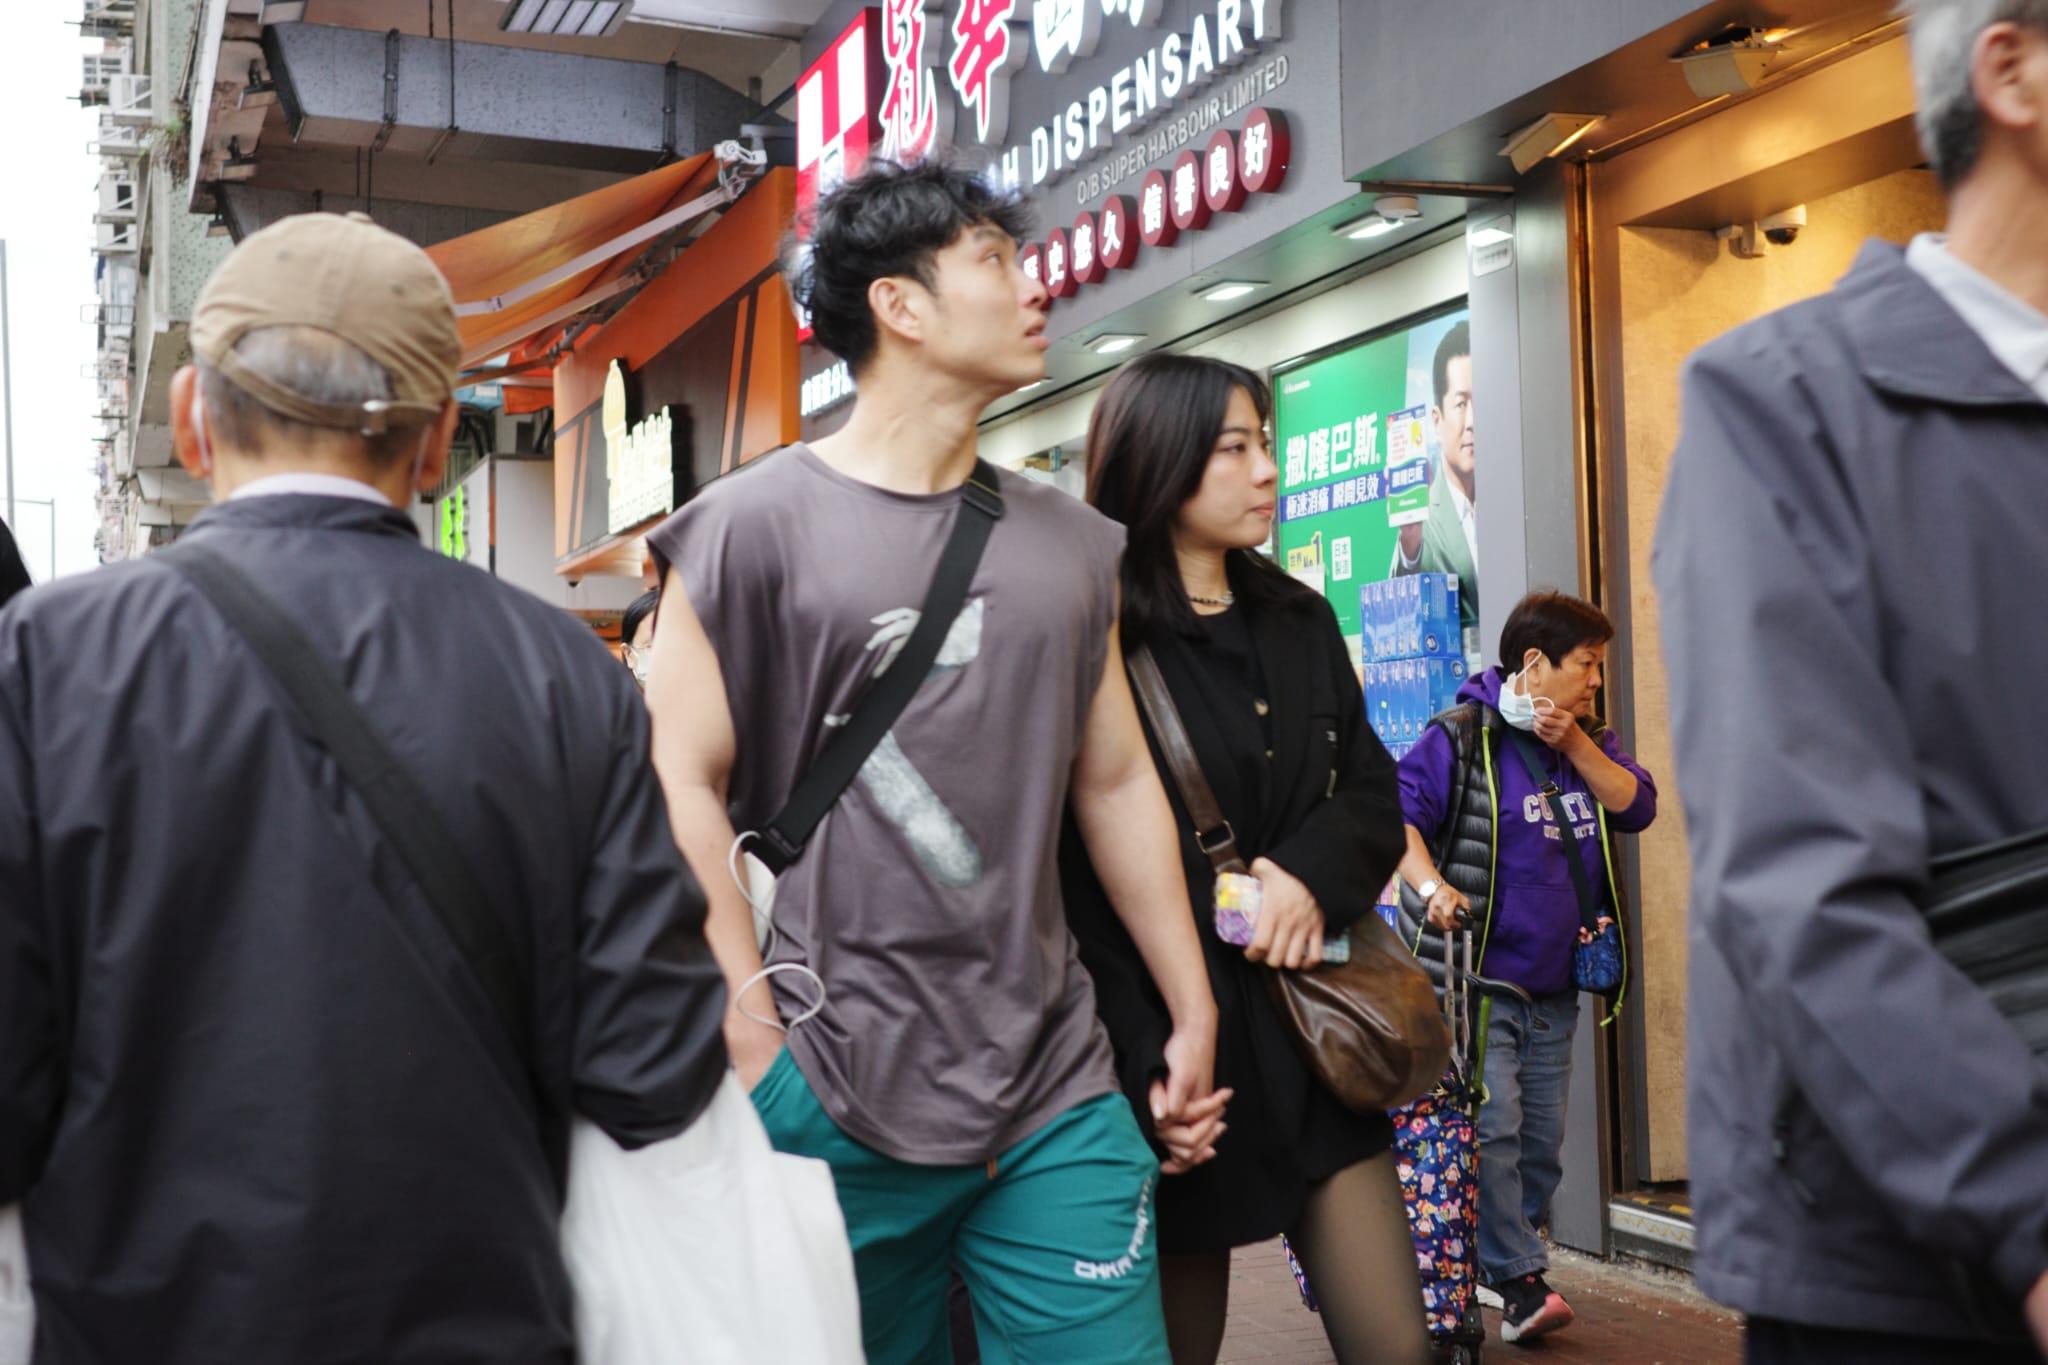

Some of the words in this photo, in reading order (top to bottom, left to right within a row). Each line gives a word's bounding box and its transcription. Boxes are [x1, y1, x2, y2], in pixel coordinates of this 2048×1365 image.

[1077, 169, 1101, 205] O/B
[1101, 145, 1151, 191] SUPER
[1149, 97, 1221, 172] HARBOUR
[1223, 55, 1289, 118] LIMITED
[1142, 121, 1268, 235] 信譽良好
